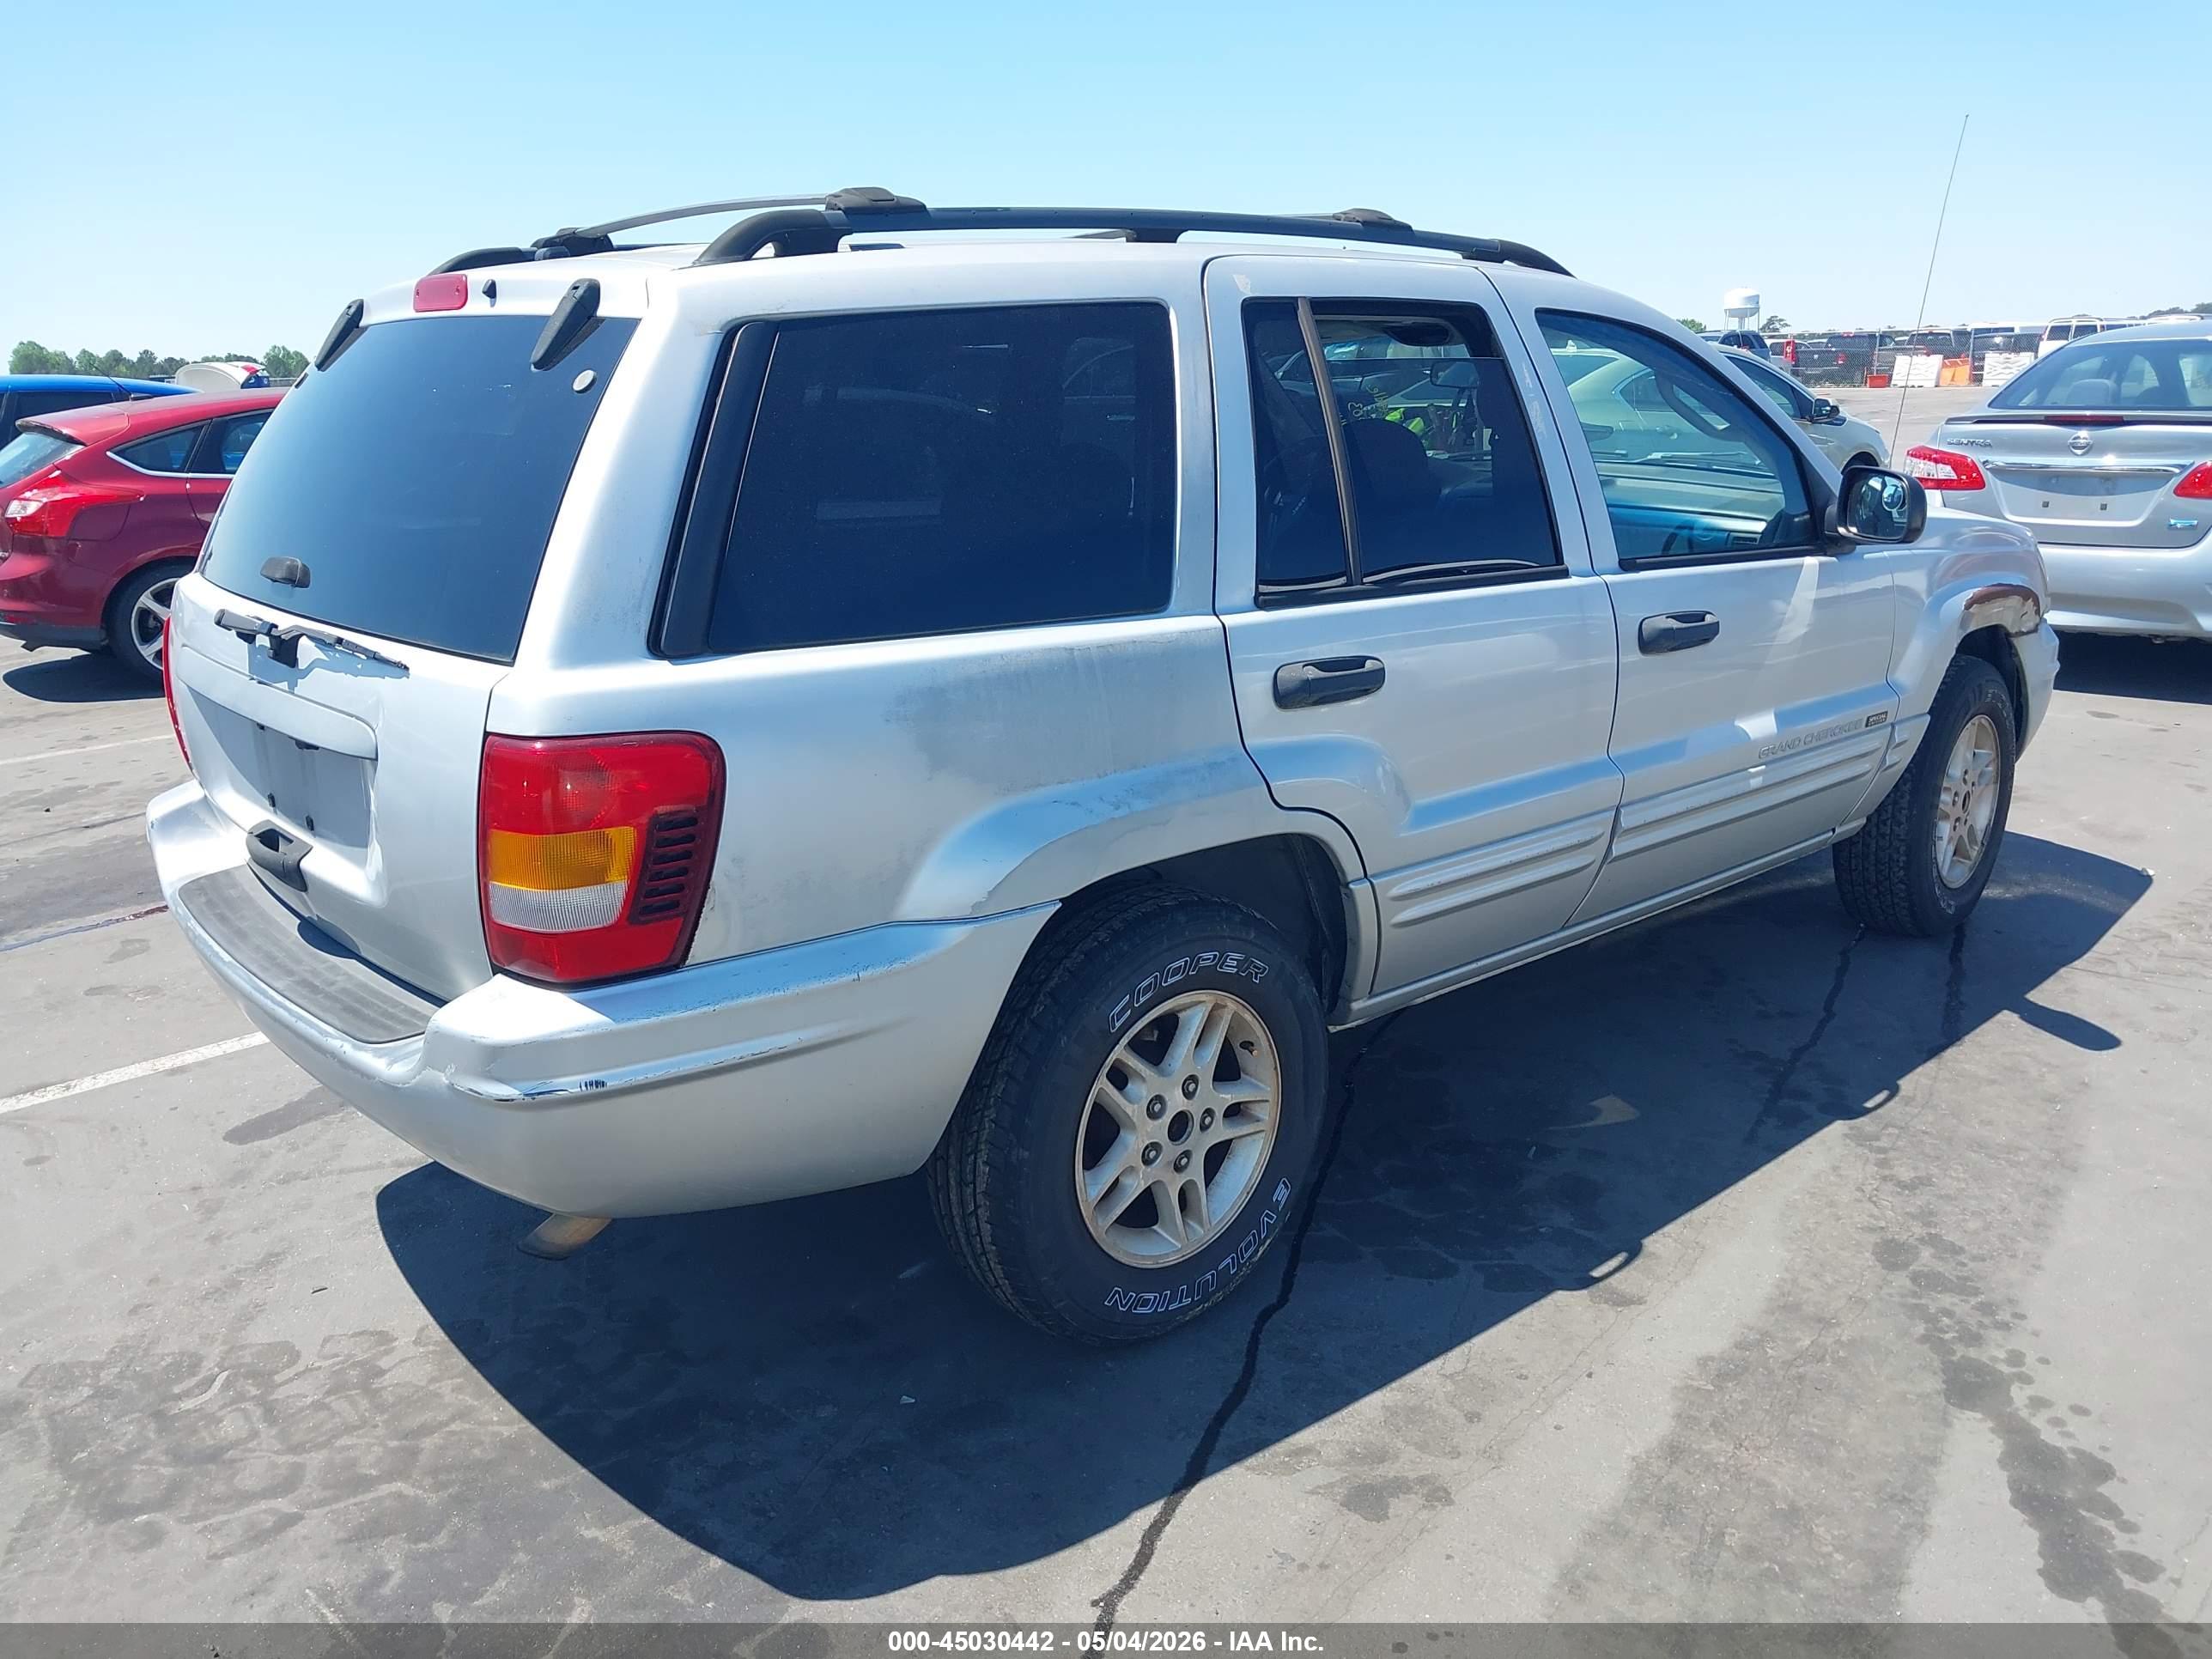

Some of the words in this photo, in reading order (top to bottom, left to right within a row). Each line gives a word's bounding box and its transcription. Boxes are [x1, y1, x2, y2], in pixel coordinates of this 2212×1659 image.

[1947, 438, 1993, 447] SENTRA
[1759, 737, 1801, 759] GRAND
[1803, 719, 1863, 745] CHEROKEE
[1109, 951, 1269, 1033] COOPER
[1104, 1177, 1291, 1313] EVOLUTION
